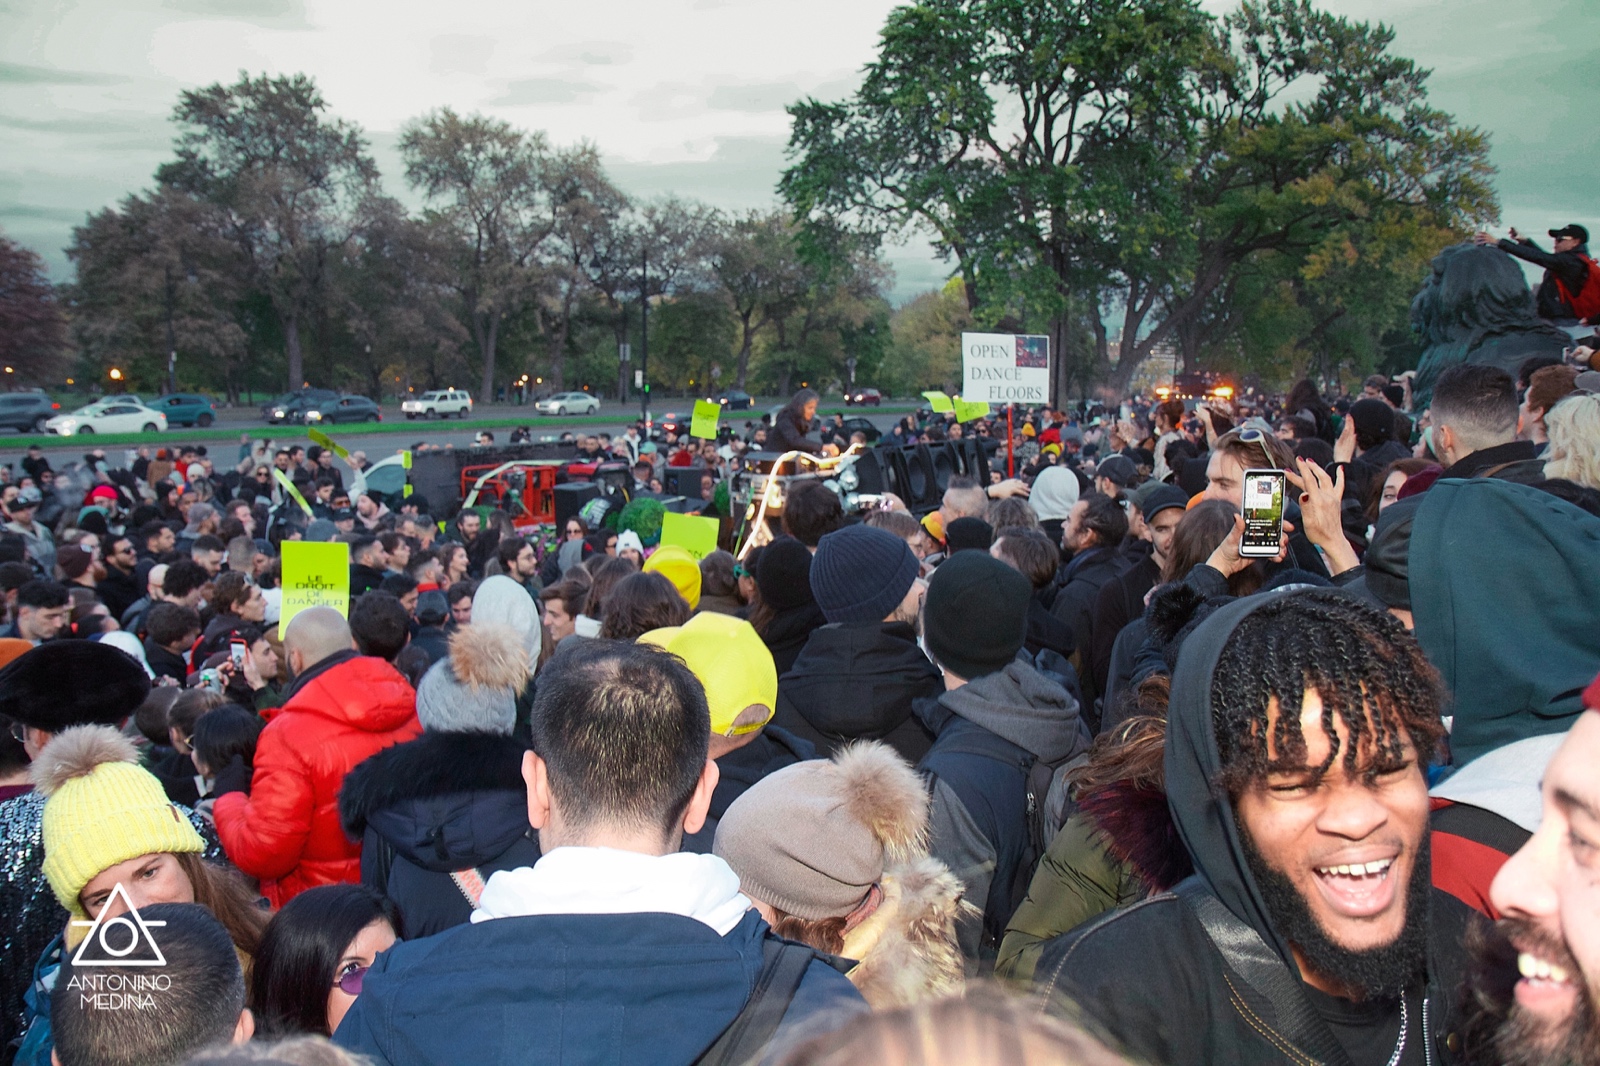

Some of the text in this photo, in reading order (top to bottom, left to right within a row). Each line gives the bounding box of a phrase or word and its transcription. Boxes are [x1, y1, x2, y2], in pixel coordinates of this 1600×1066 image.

[970, 344, 1009, 358] OPEN
[971, 367, 1022, 381] DANCE
[989, 386, 1042, 400] FLOORS
[295, 582, 336, 590] DROIT
[307, 575, 323, 583] LE
